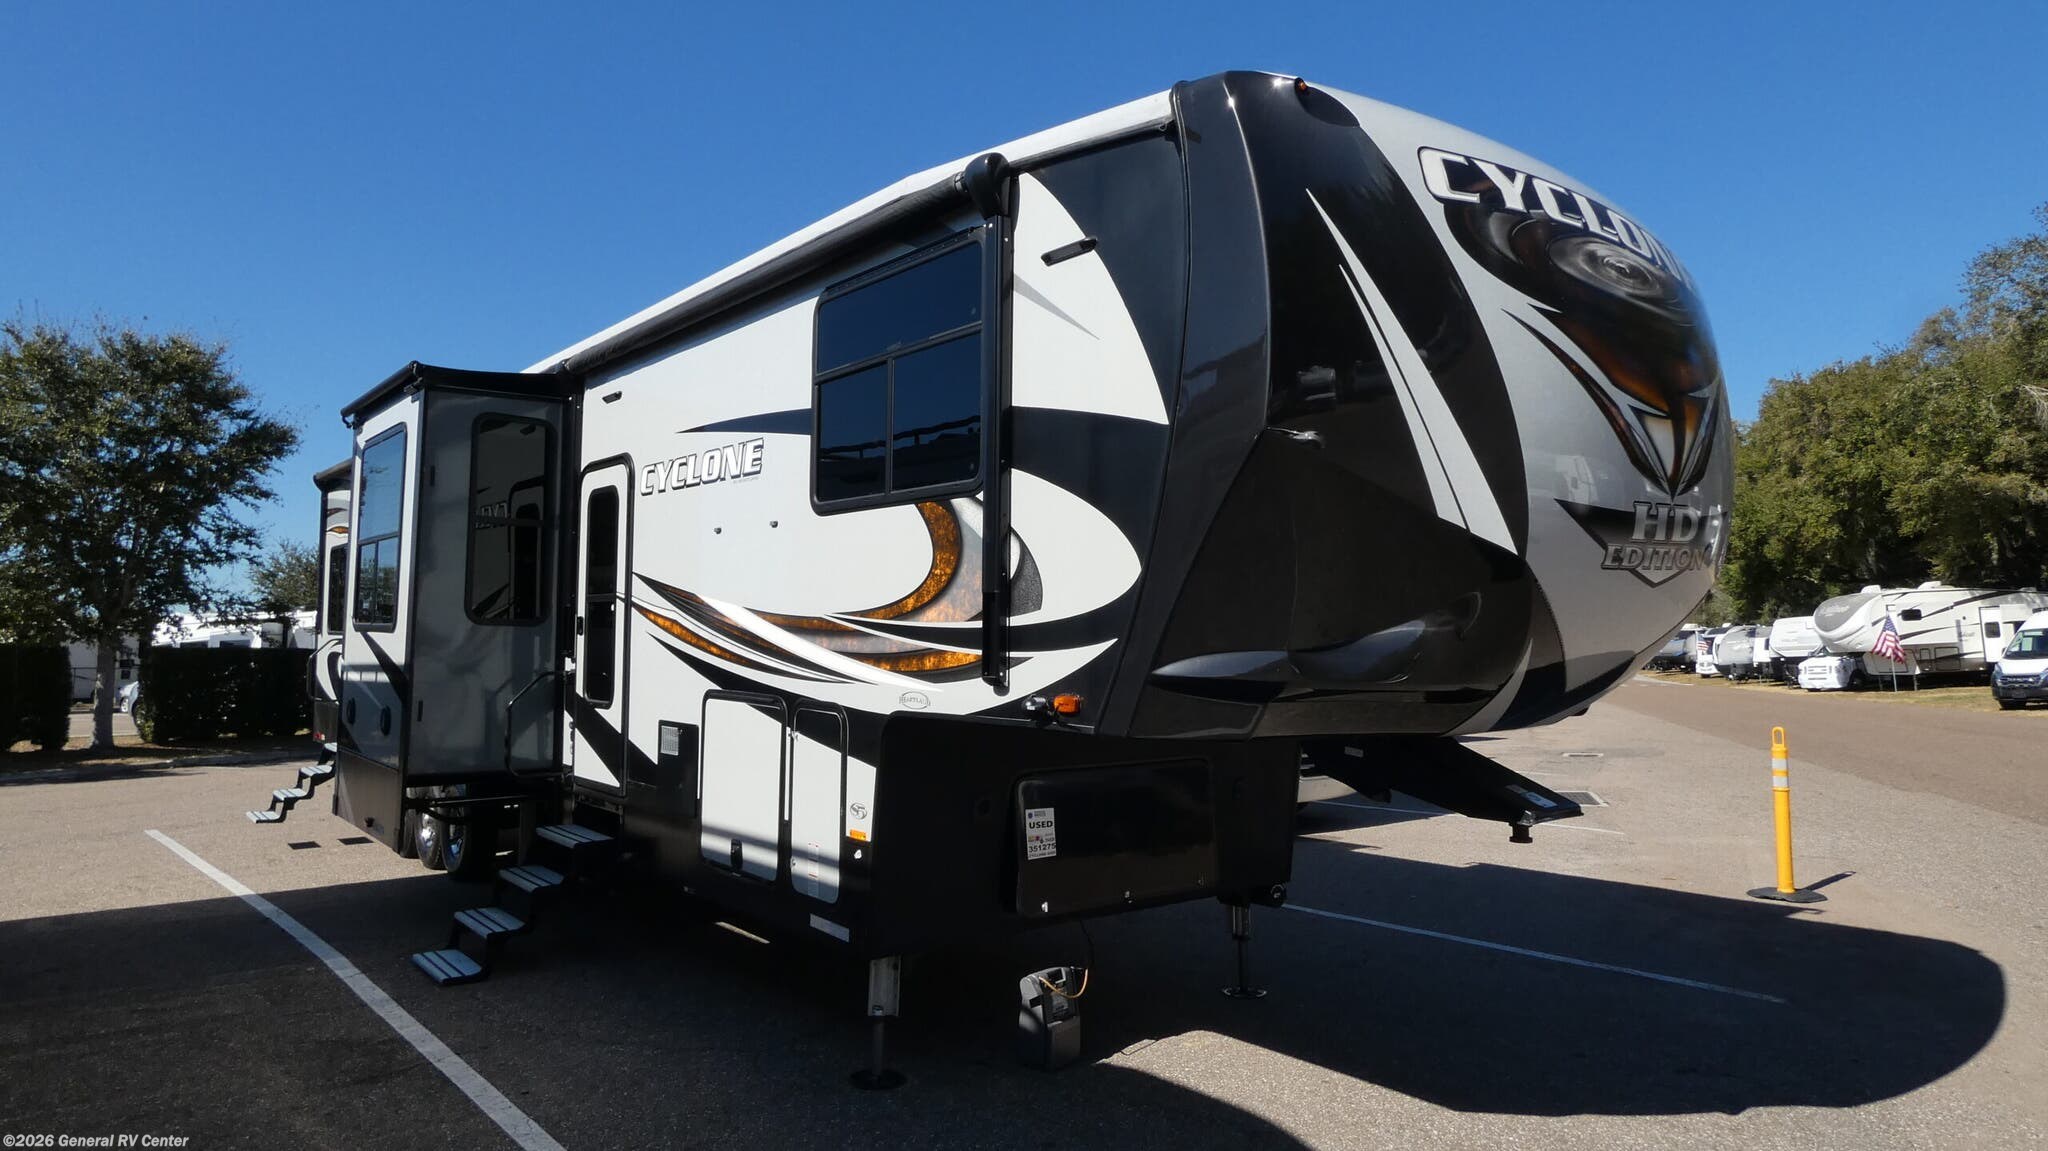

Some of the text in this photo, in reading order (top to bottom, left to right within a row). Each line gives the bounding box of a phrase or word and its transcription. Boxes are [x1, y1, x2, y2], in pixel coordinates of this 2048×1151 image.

[640, 437, 764, 496] CYCLONE
[1601, 544, 1704, 570] EDITION
[1028, 820, 1053, 829] USED
[1028, 843, 1056, 853] 351275
